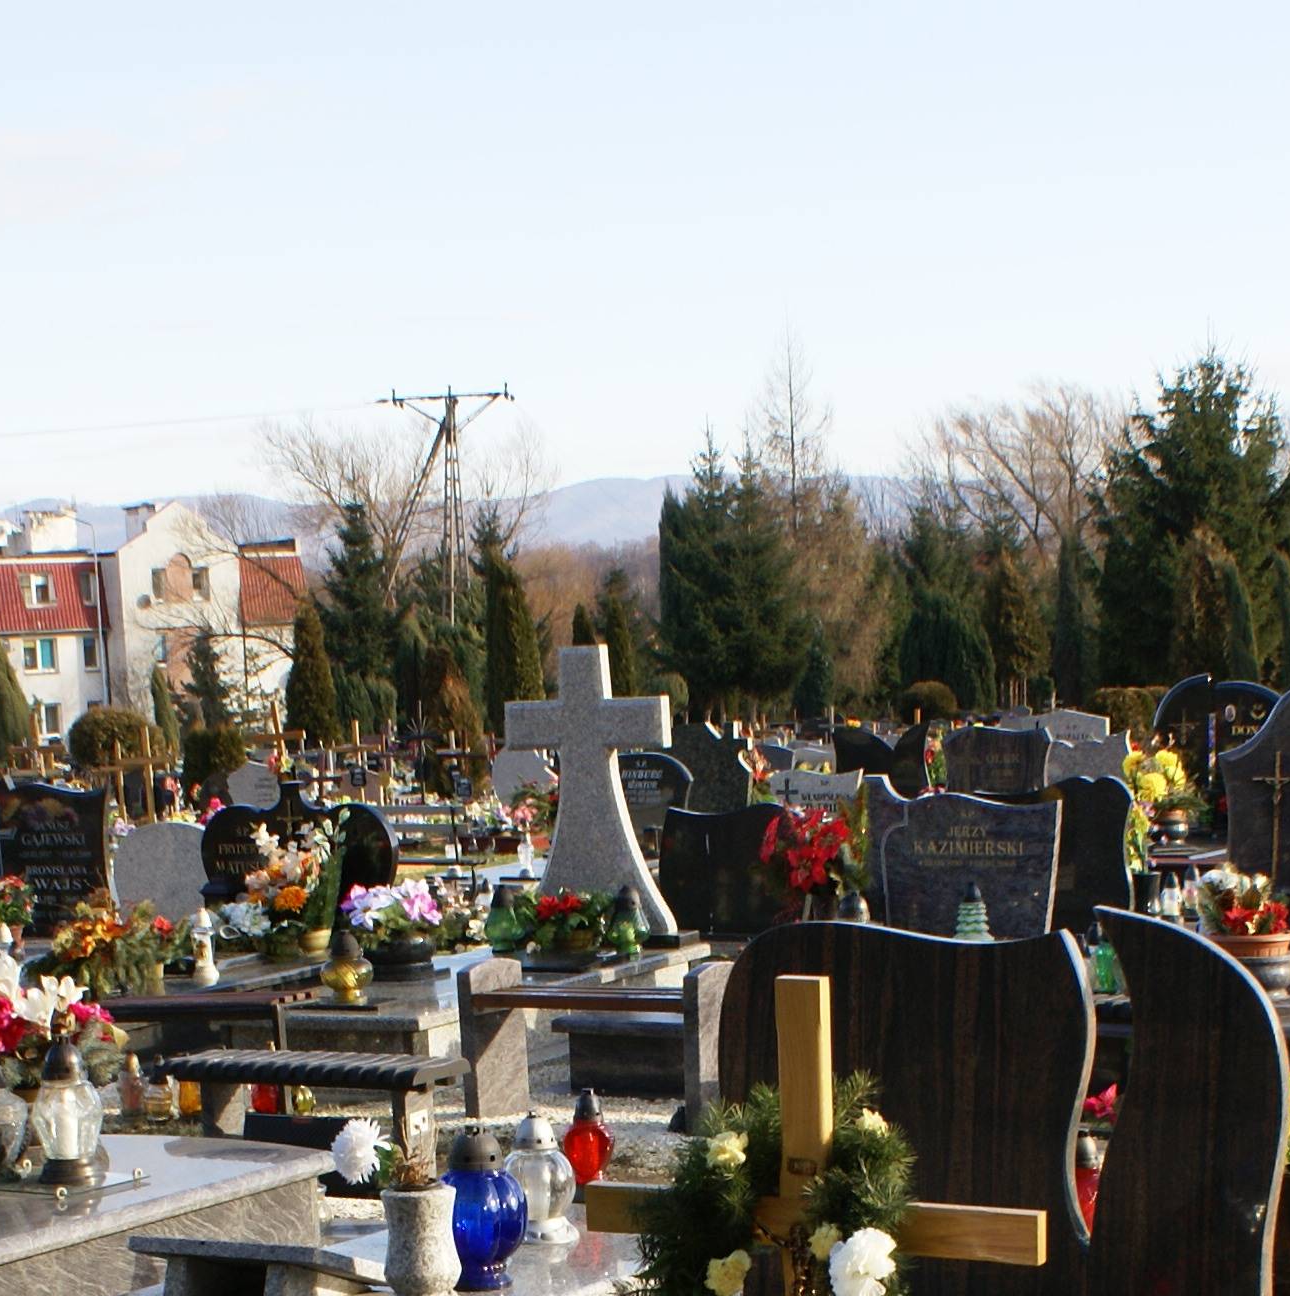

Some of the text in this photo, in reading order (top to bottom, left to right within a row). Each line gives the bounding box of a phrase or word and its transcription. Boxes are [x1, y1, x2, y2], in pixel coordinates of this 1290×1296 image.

[947, 825, 988, 838] JERZY
[20, 832, 87, 848] GAJEWSKI
[912, 840, 1026, 857] KAZIMIERSKI
